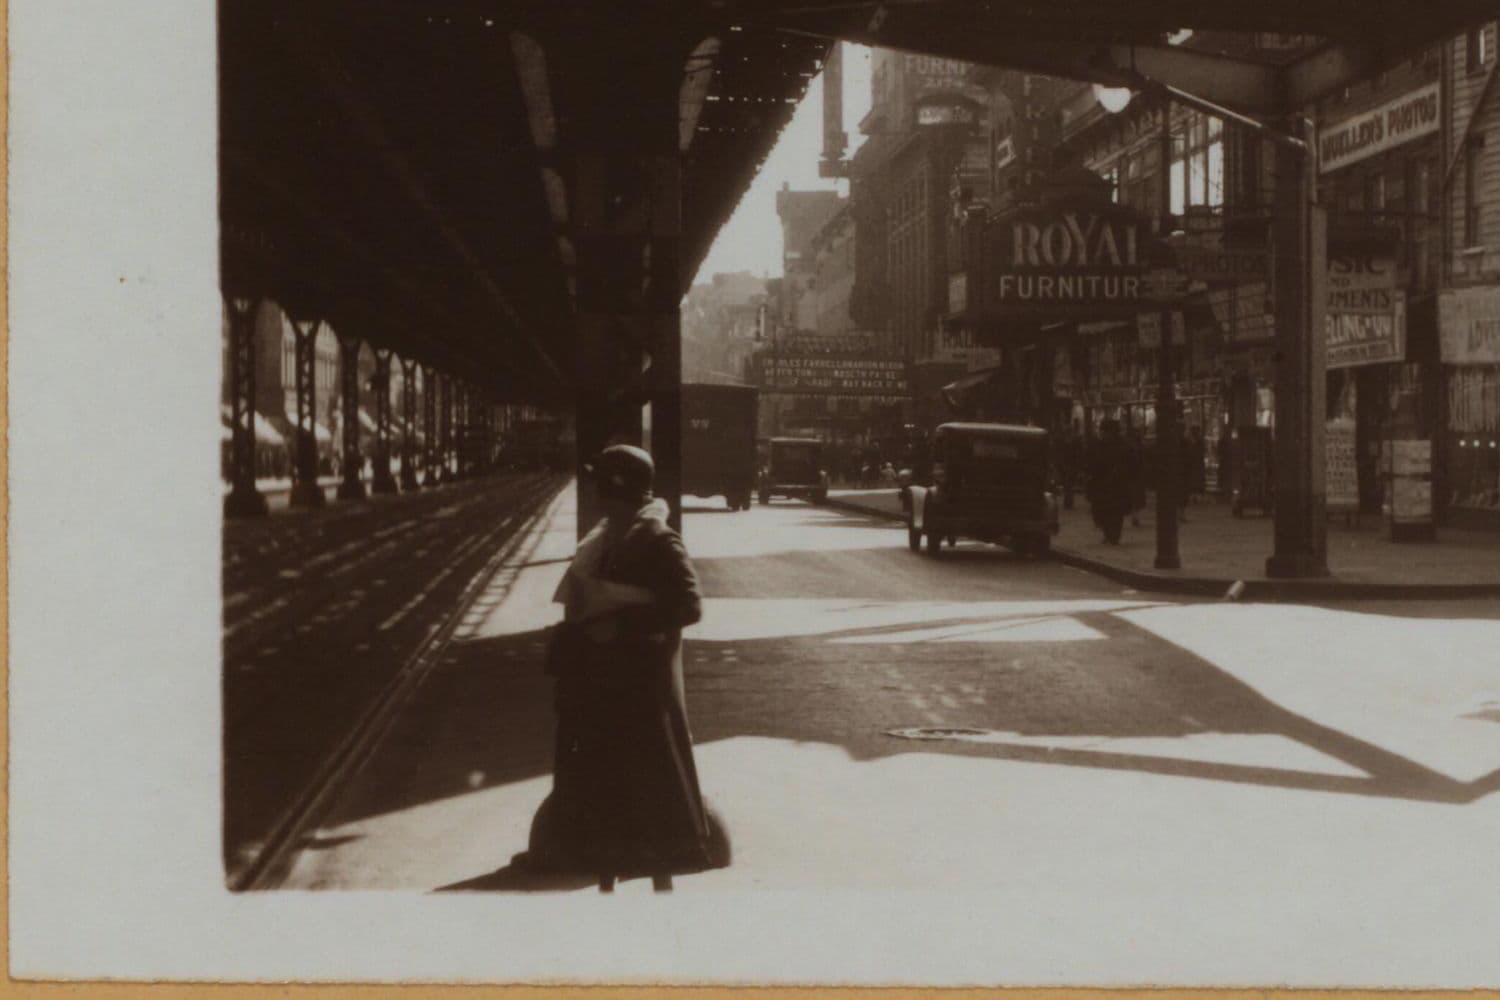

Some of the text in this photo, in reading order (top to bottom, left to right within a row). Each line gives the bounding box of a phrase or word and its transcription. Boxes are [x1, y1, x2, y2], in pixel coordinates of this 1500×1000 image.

[1388, 92, 1437, 137] PHOTOS
[1326, 254, 1387, 274] SIC
[1000, 275, 1140, 300] FURNITUR
